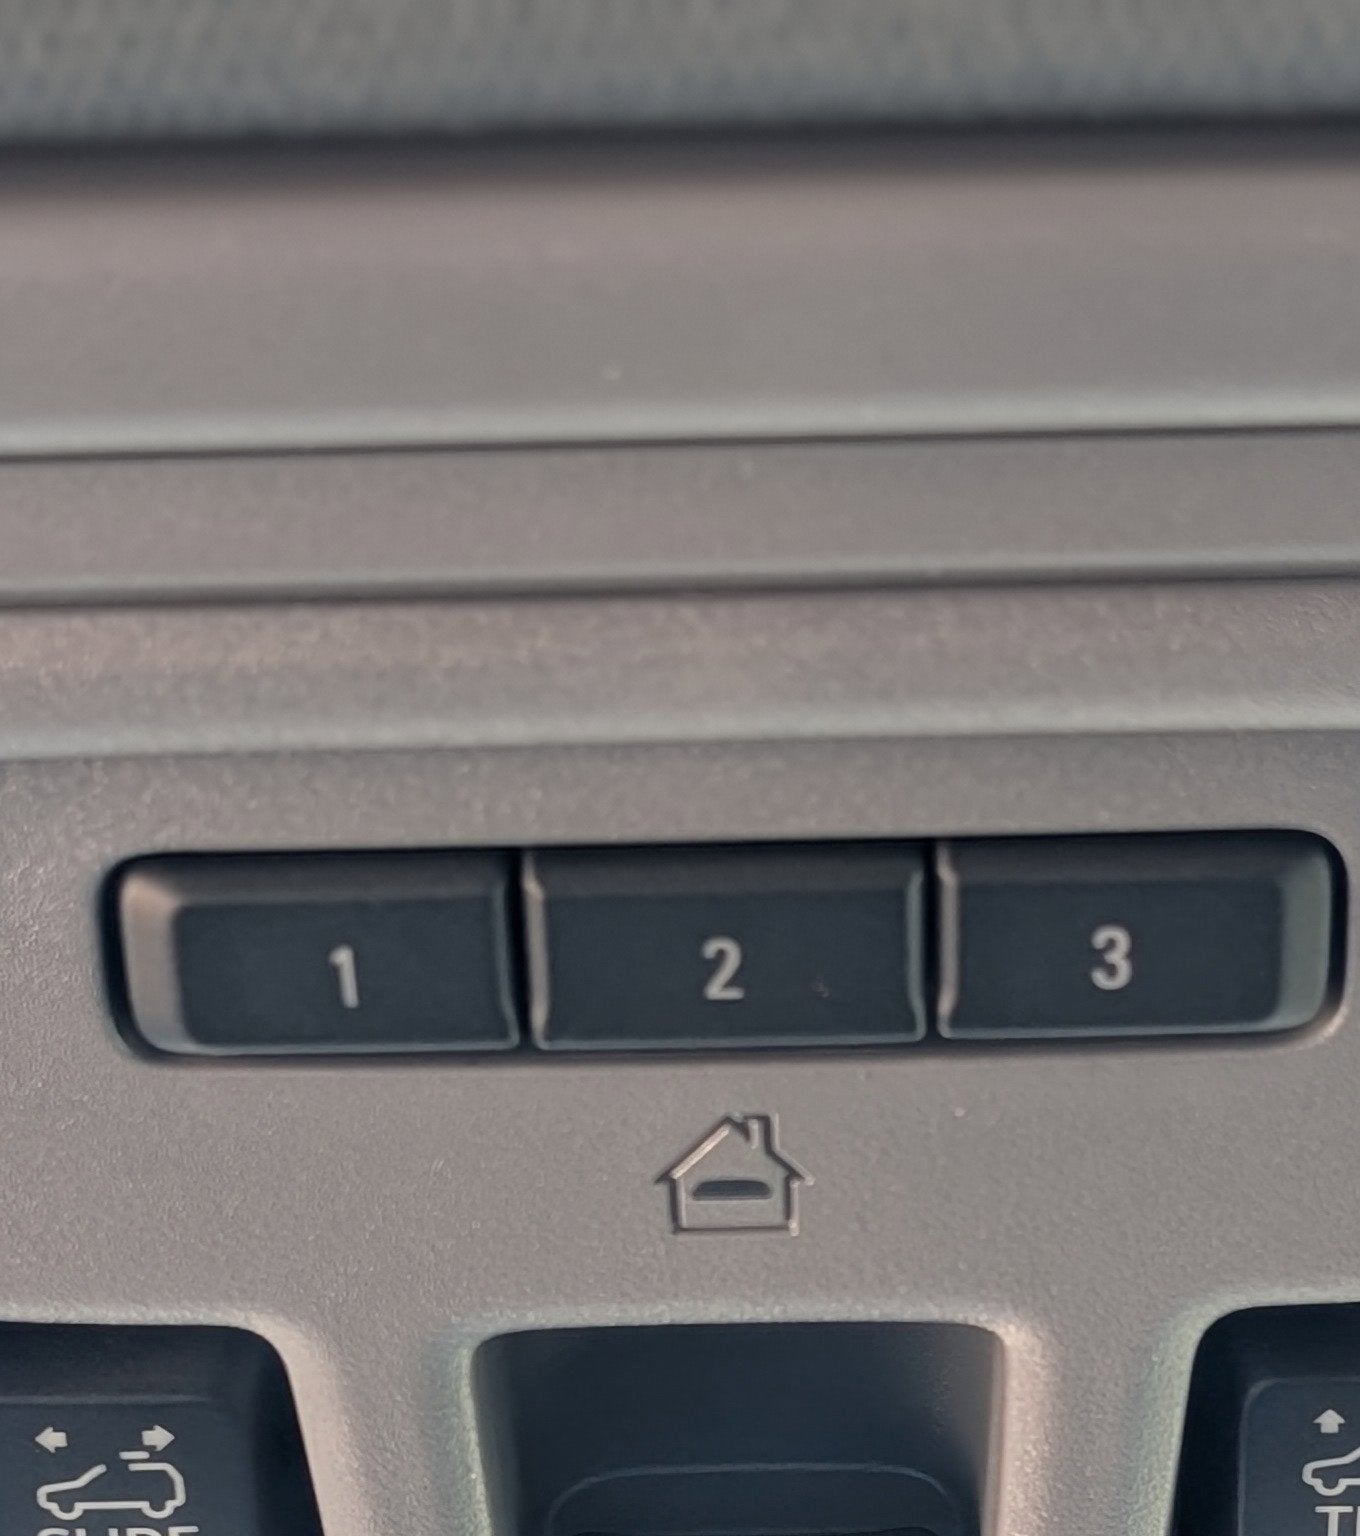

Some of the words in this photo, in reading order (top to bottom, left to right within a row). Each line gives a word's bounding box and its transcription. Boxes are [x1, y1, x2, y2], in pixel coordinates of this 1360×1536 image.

[328, 945, 361, 1009] 1
[702, 936, 744, 1001] 2
[1089, 925, 1133, 990] 3
